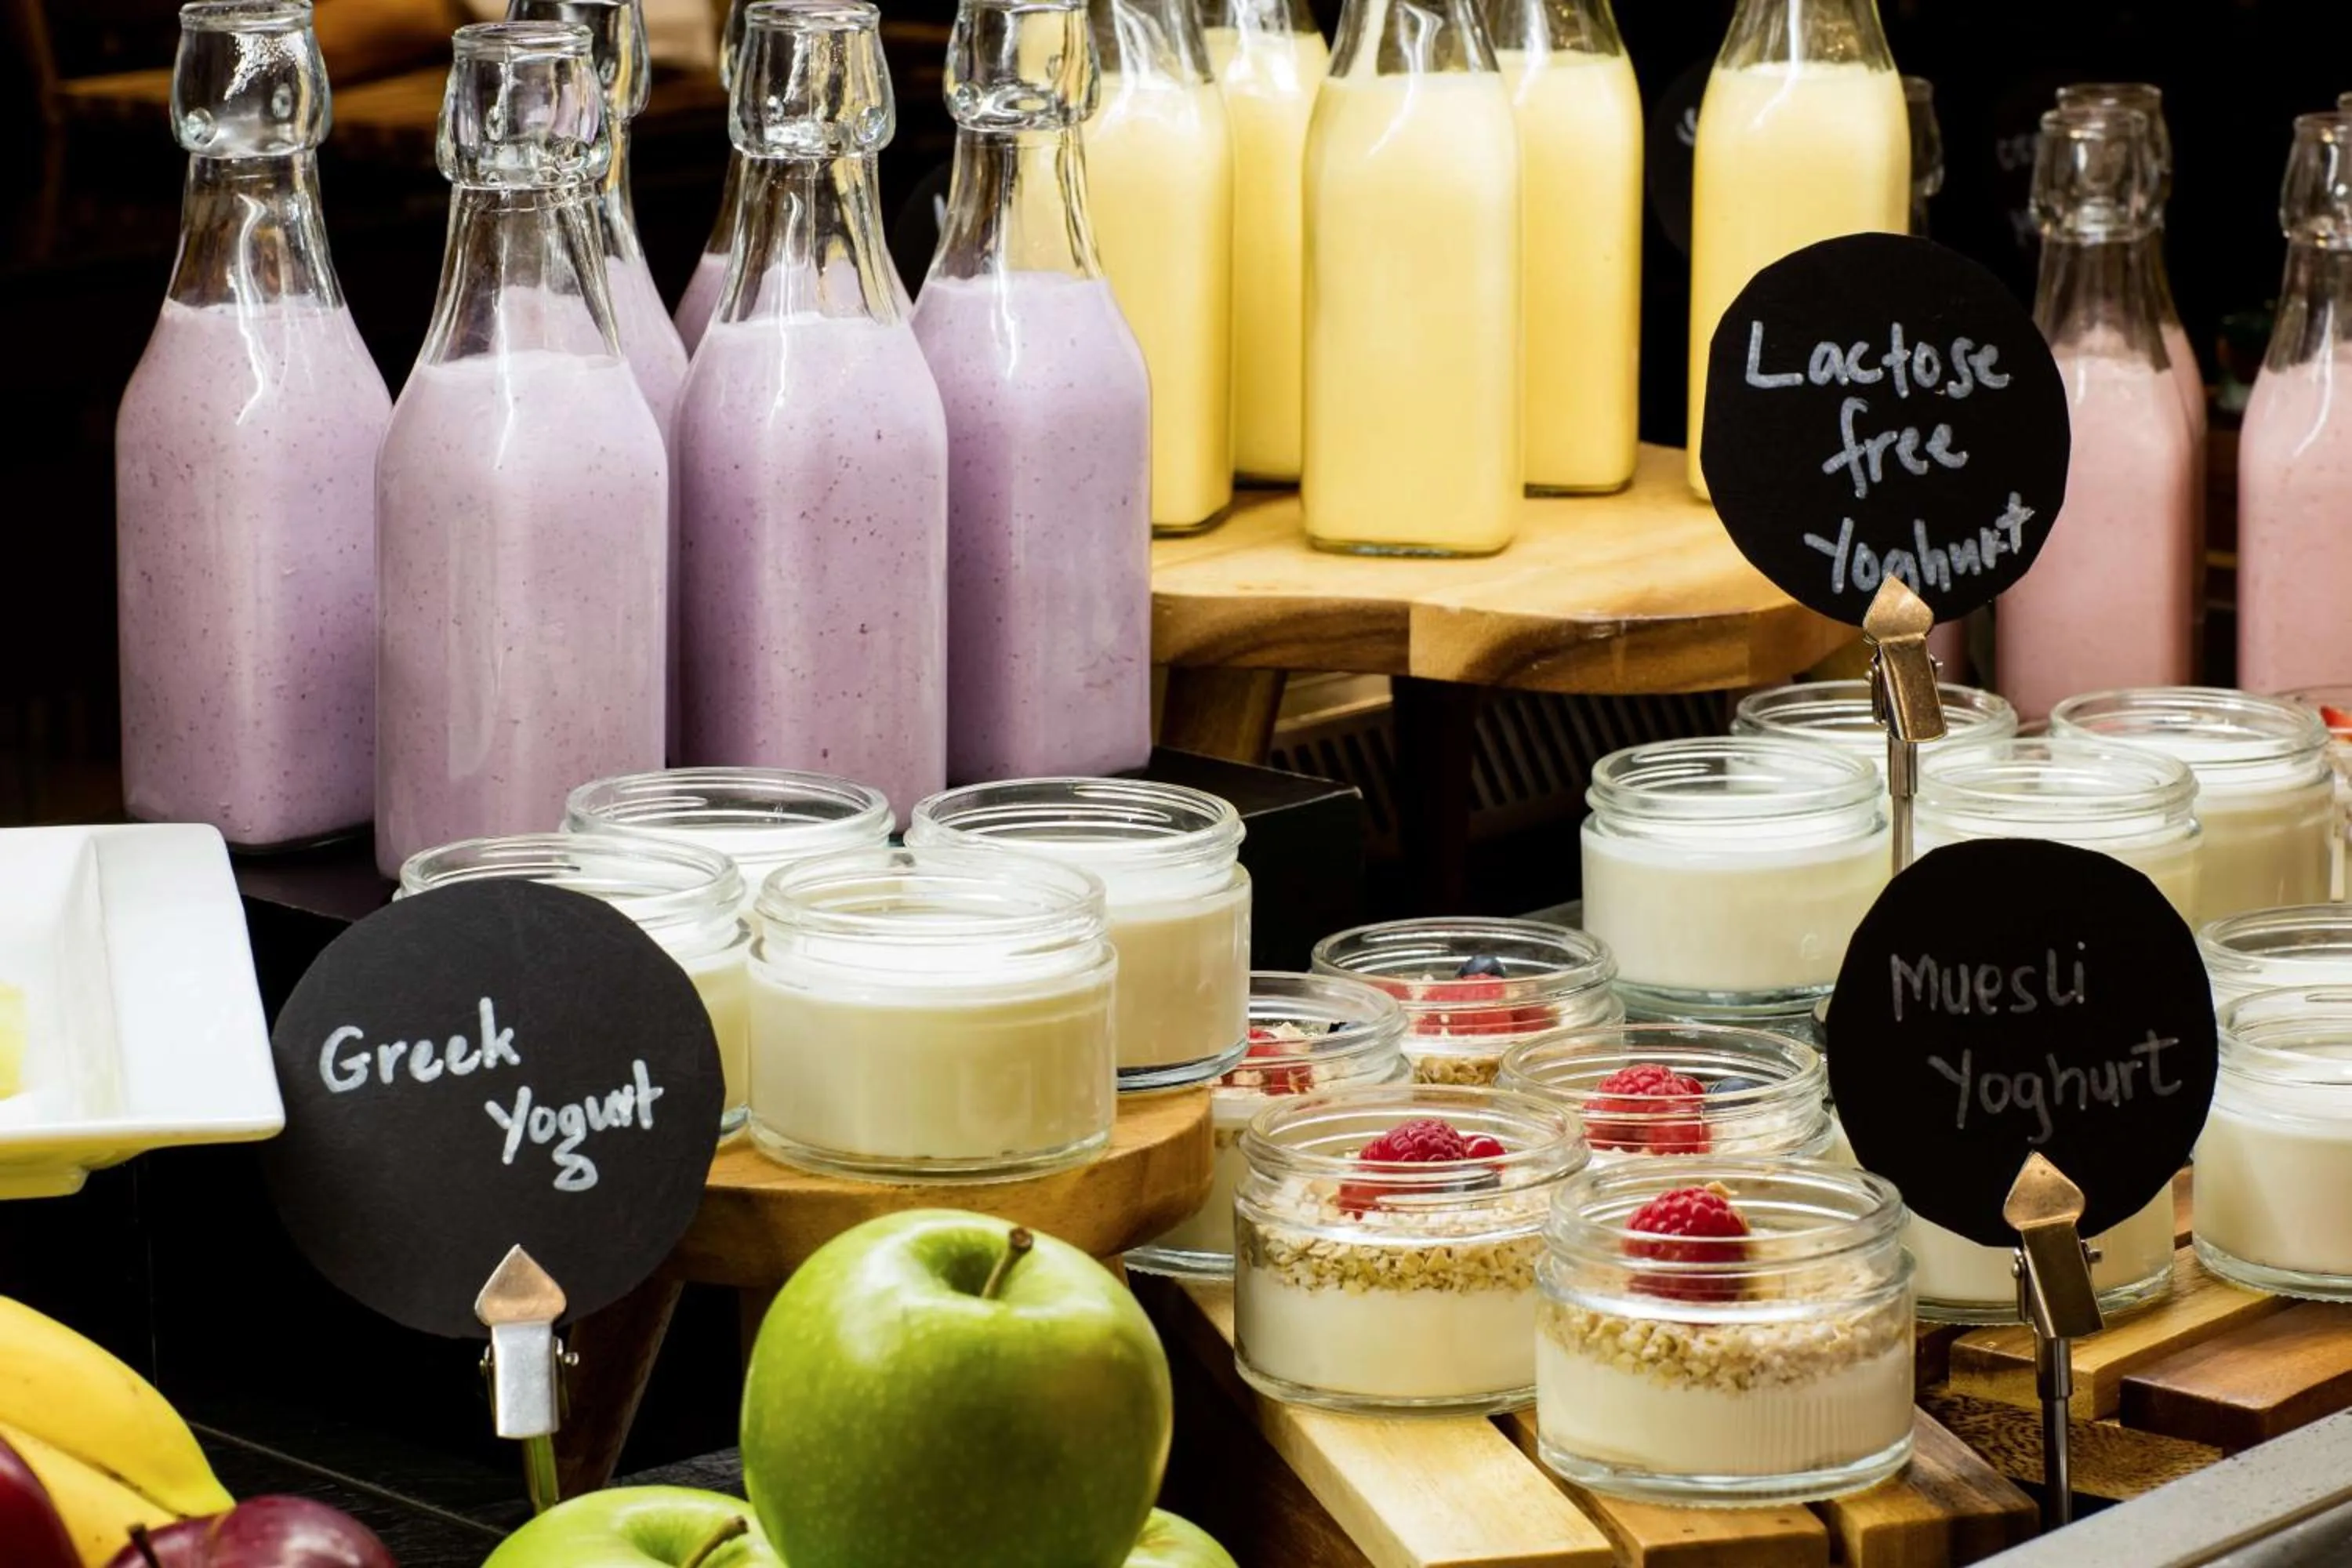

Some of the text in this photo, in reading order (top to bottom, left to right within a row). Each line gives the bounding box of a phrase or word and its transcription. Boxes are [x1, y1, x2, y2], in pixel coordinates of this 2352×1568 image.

[1745, 321, 2011, 398] Lactose
[1822, 397, 1969, 499] free
[1889, 941, 2086, 1022] Muesli
[318, 996, 521, 1094] Greek
[1926, 1029, 2183, 1145] Yoghurt
[484, 1058, 665, 1192] Yogurt
